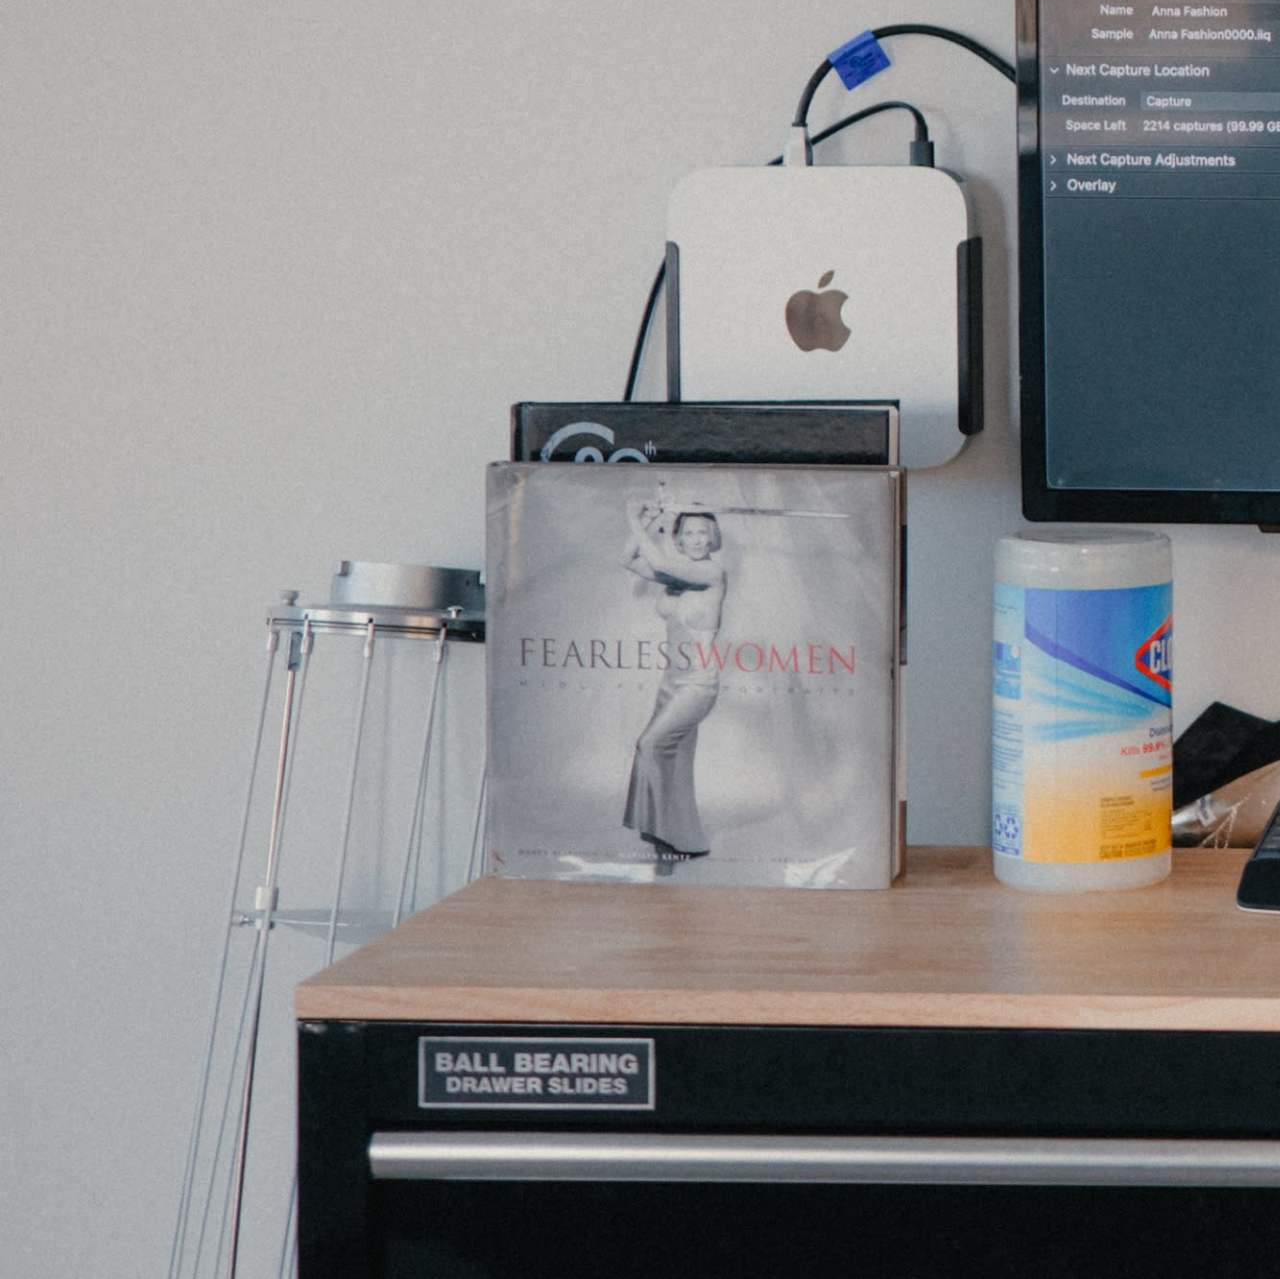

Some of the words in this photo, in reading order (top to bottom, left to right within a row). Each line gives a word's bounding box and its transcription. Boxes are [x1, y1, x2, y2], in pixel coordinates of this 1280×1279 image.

[1100, 4, 1134, 16] Name
[1151, 5, 1181, 17] Anna
[1183, 5, 1228, 17] Fashion
[1091, 28, 1134, 41] Sample
[1149, 28, 1178, 40] Anna
[1066, 64, 1096, 77] Next
[1098, 64, 1151, 79] Capture
[1154, 64, 1210, 77] Location
[1062, 94, 1126, 106] Destination
[1146, 95, 1192, 108] Capture
[1065, 120, 1103, 133] Space
[1105, 120, 1127, 131] Left
[1143, 120, 1170, 132] 2214
[1173, 121, 1224, 134] captures
[1067, 153, 1097, 166] Next
[1099, 153, 1152, 169] Capture
[1154, 153, 1236, 169] Adjustments
[1067, 179, 1117, 194] Overlay
[1150, 639, 1173, 674] CL
[435, 1051, 506, 1073] BALL
[513, 1052, 639, 1074] BEARING
[445, 1076, 543, 1094] DRAWER
[547, 1077, 628, 1095] SLIDES
